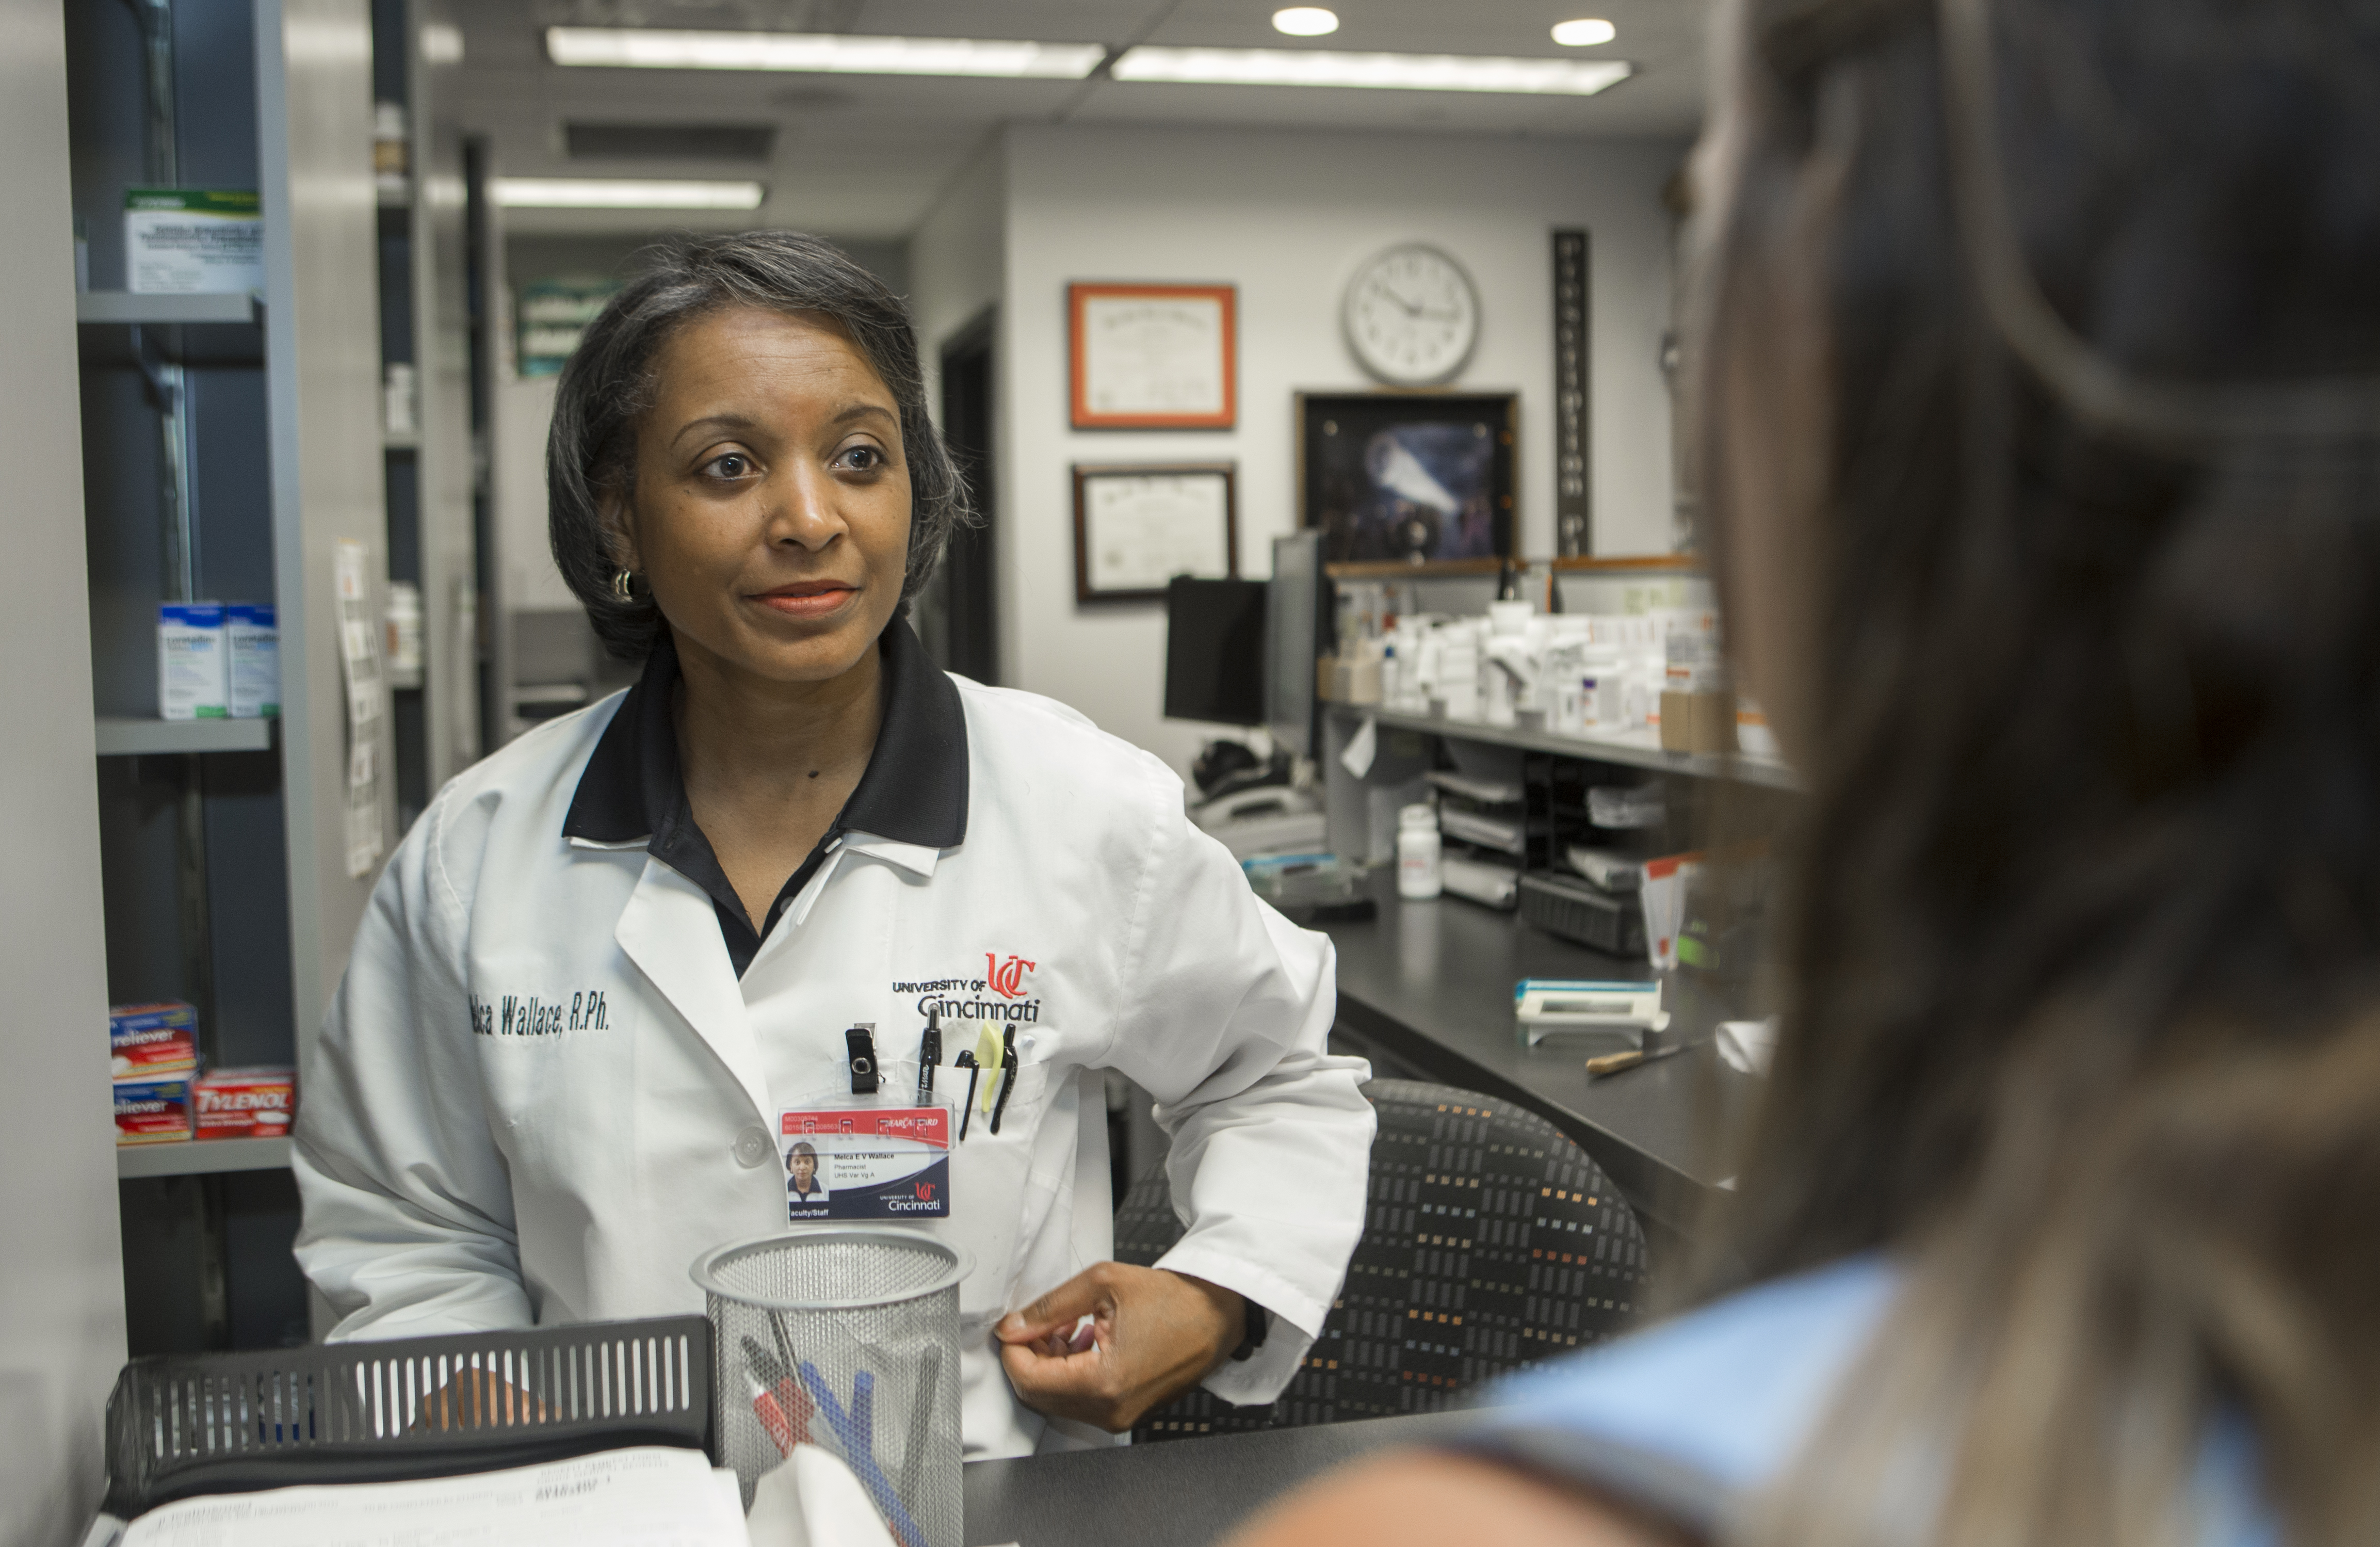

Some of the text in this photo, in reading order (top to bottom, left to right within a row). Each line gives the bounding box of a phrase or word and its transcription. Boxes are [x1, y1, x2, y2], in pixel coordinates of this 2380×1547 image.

[893, 979, 986, 993] UNIVERSITY OF
[501, 995, 563, 1039] Wallace,
[569, 990, 609, 1031] R.Ph.
[918, 994, 1041, 1022] Cincinnati
[114, 1028, 176, 1048] reliever
[115, 1098, 169, 1116] eliever
[790, 1208, 829, 1218] aculty/Staff
[888, 1199, 940, 1211] Cincinnati
